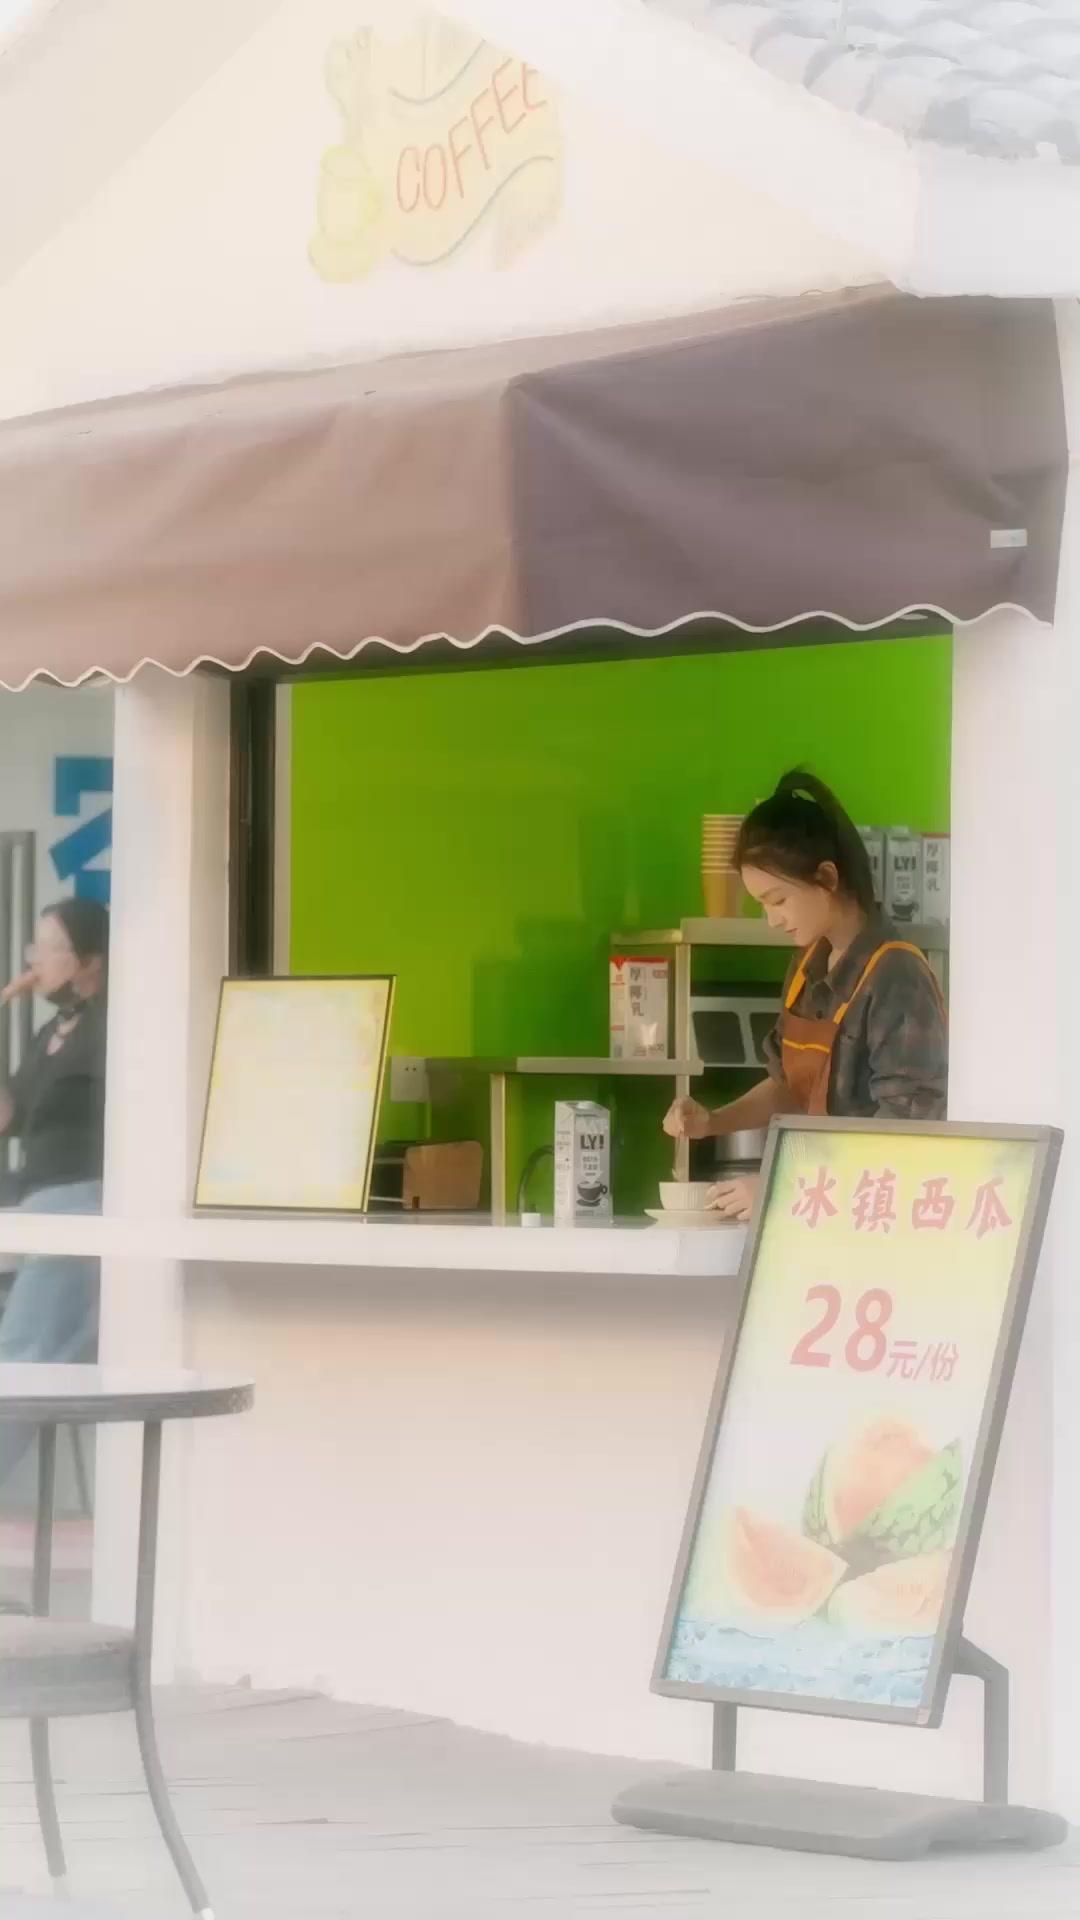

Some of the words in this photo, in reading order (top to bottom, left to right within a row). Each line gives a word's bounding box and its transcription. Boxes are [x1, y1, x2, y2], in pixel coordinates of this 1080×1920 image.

[396, 56, 548, 213] COFFEE
[580, 1134, 605, 1150] LY!
[791, 1164, 1013, 1240] 冰镇西瓜
